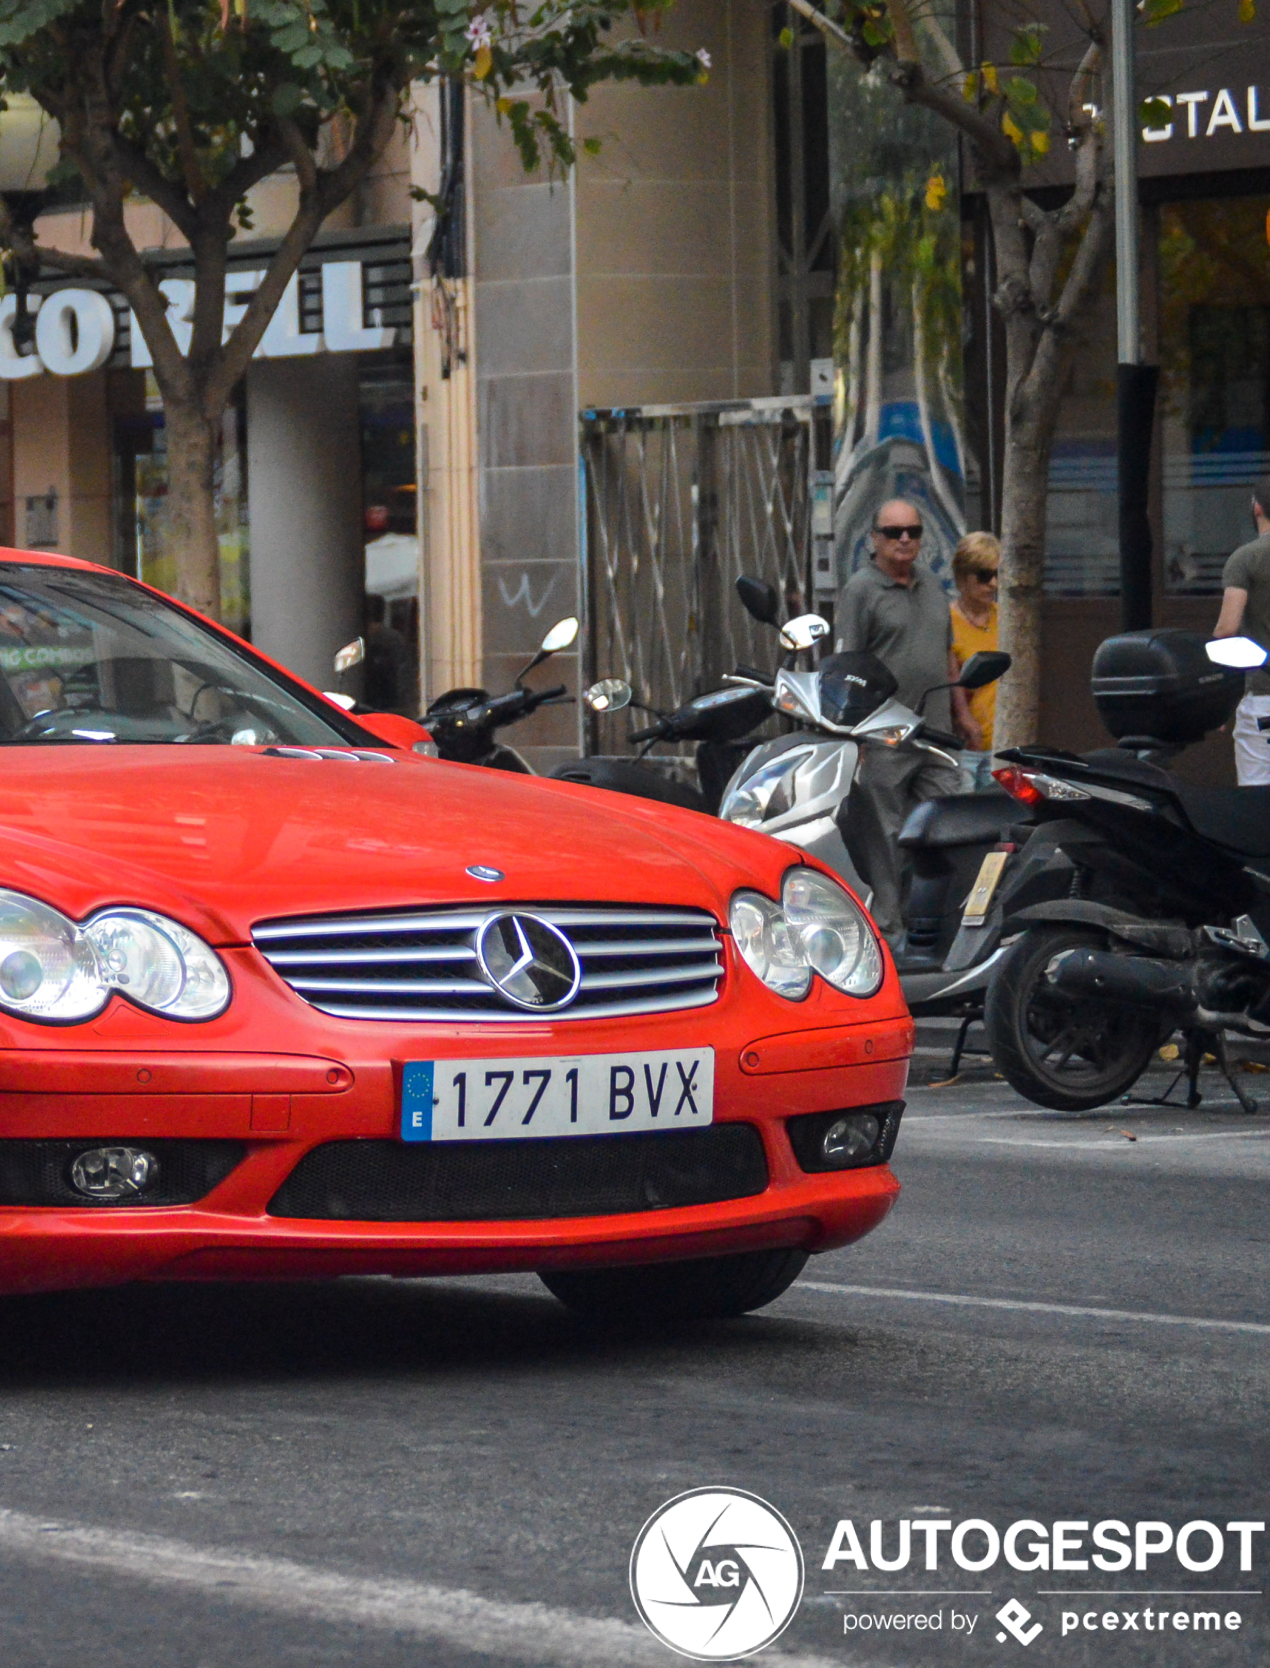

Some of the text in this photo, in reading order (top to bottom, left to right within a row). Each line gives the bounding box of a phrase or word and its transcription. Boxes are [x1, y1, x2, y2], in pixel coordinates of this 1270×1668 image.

[453, 1060, 700, 1127] 1771 BVX
[412, 1111, 423, 1128] E
